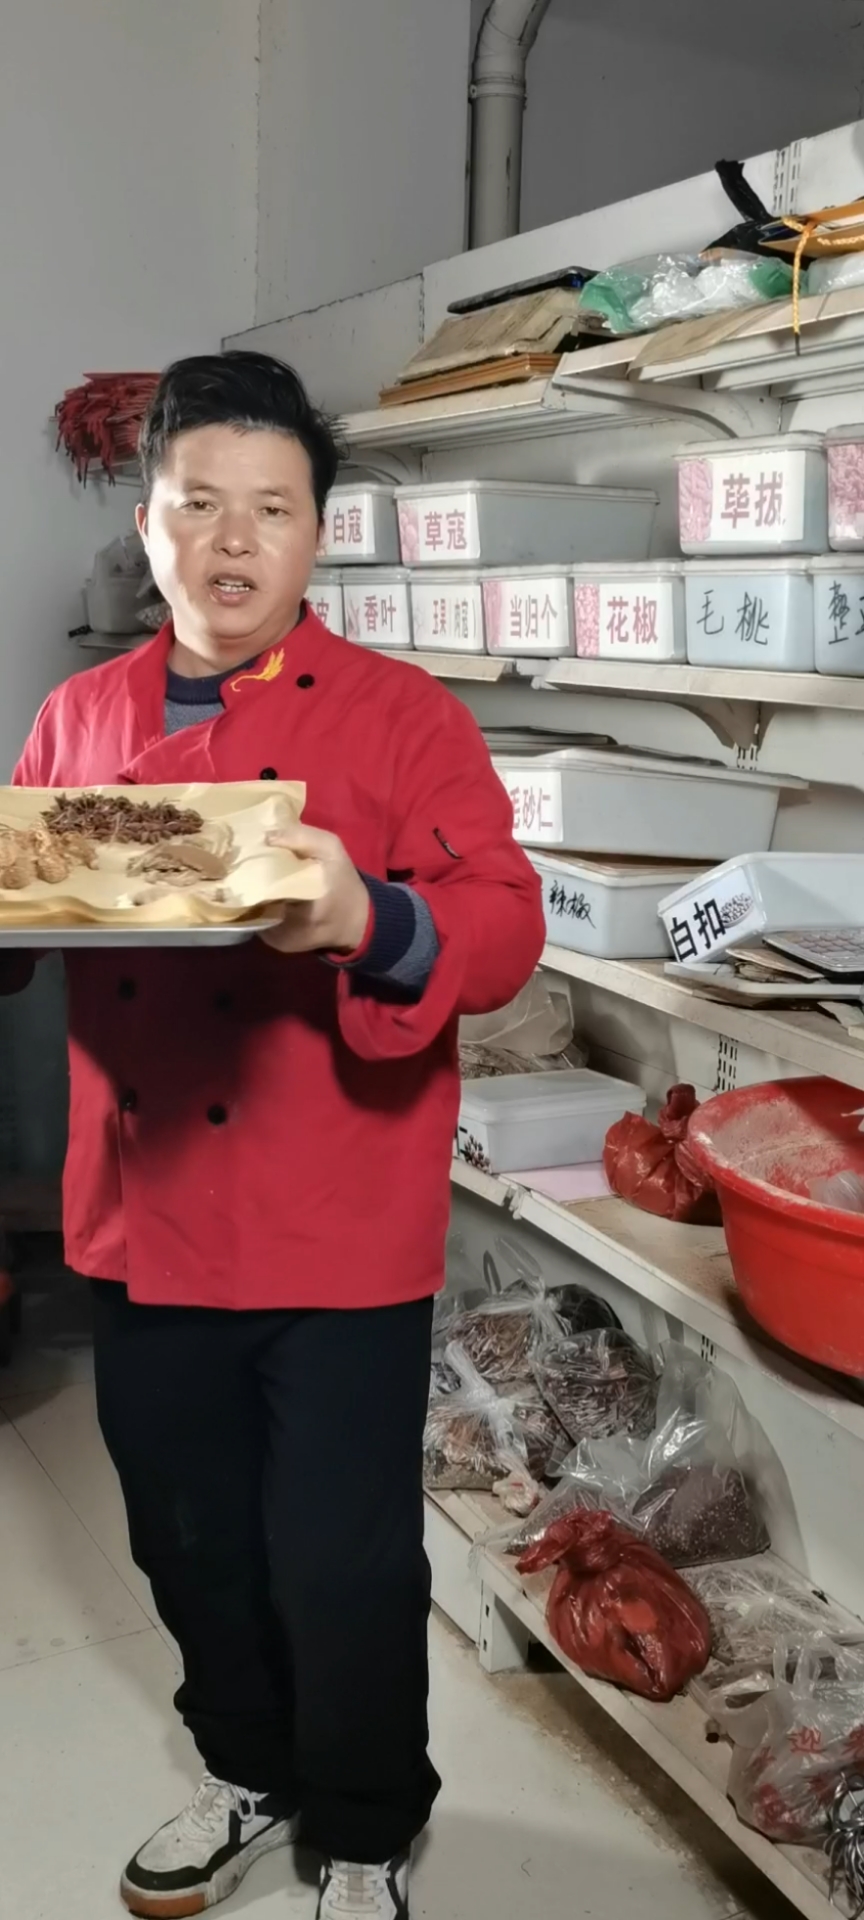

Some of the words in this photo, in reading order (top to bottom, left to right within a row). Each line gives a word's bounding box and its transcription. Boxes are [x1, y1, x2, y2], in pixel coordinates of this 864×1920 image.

[364, 594, 397, 633] 香叶
[509, 593, 558, 640] 当归个
[606, 595, 658, 645] 花椒
[696, 588, 770, 646] 毛桃
[670, 897, 726, 963] 白扣
